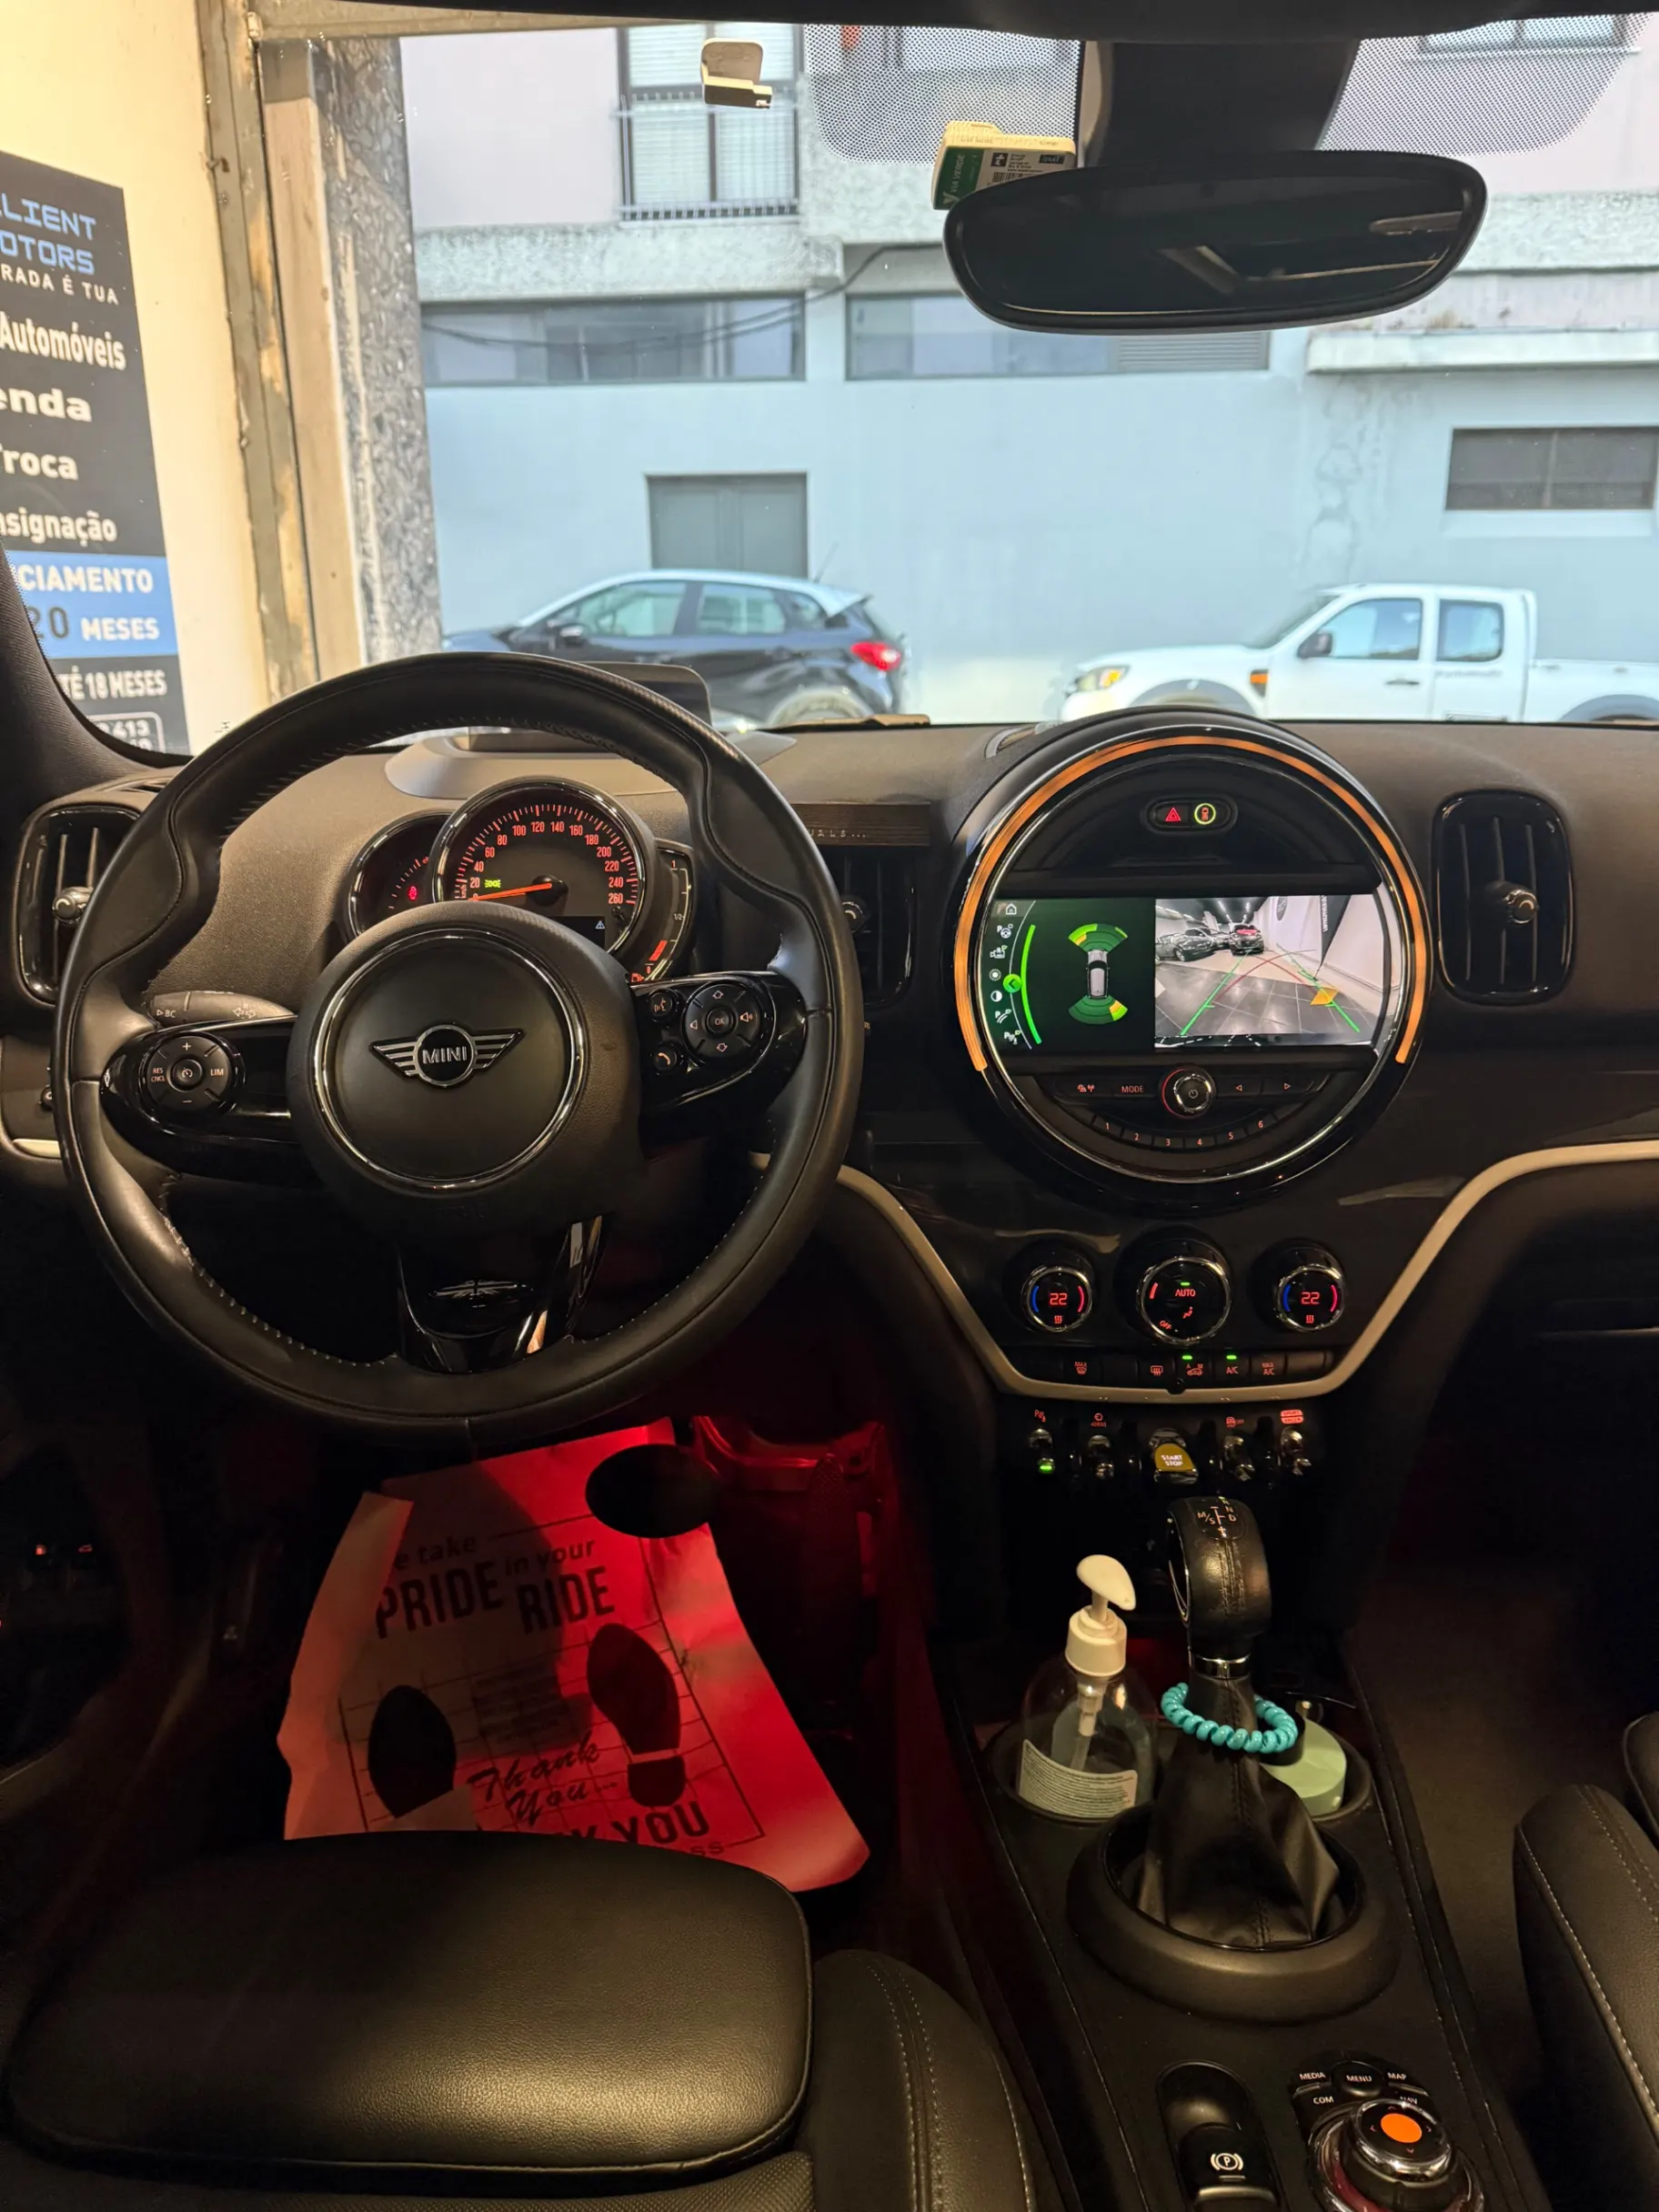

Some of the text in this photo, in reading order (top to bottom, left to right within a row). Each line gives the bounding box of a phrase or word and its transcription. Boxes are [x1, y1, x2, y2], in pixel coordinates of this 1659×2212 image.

[0, 192, 96, 241] LIENT
[62, 274, 75, 296] É
[81, 281, 119, 306] TUA
[0, 310, 126, 371] Automóveis
[80, 617, 160, 641] MESES
[108, 669, 167, 699] MESES
[512, 825, 526, 836] 100
[531, 821, 545, 832] 120
[550, 821, 564, 832] 140
[569, 825, 583, 837] 160
[497, 834, 508, 846] 80
[584, 834, 598, 846] 180
[485, 847, 495, 858] 60
[597, 847, 611, 858] 200
[474, 861, 484, 872] 40
[605, 860, 619, 872] 220
[470, 877, 480, 889] 20
[608, 877, 624, 889] 240
[608, 893, 623, 905] 260
[674, 913, 683, 921] 1/2
[165, 1010, 176, 1019] BC
[714, 1018, 725, 1026] OK
[422, 1046, 467, 1064] MINI
[210, 1069, 224, 1077] LIM
[1121, 1085, 1144, 1093] MODE
[1105, 1121, 1110, 1130] 1
[1258, 1120, 1263, 1129] 6
[1134, 1133, 1139, 1141] 2
[1165, 1139, 1171, 1147] 3
[1197, 1139, 1203, 1147] 4
[1174, 1289, 1196, 1297] AUTO
[1301, 1292, 1320, 1305] 22
[1049, 1292, 1068, 1306] 22
[1159, 1320, 1172, 1330] OFF
[1226, 1365, 1239, 1374] A/C
[417, 1535, 477, 1565] take
[537, 1540, 596, 1570] your
[375, 1560, 505, 1640] PRIDE
[515, 1565, 616, 1635] RIDE
[466, 1730, 600, 1803] Thank
[1299, 2072, 1326, 2081] MEDIA
[1346, 2075, 1372, 2083] MENU
[1387, 2072, 1407, 2081] MAP
[1312, 2096, 1334, 2105] COM
